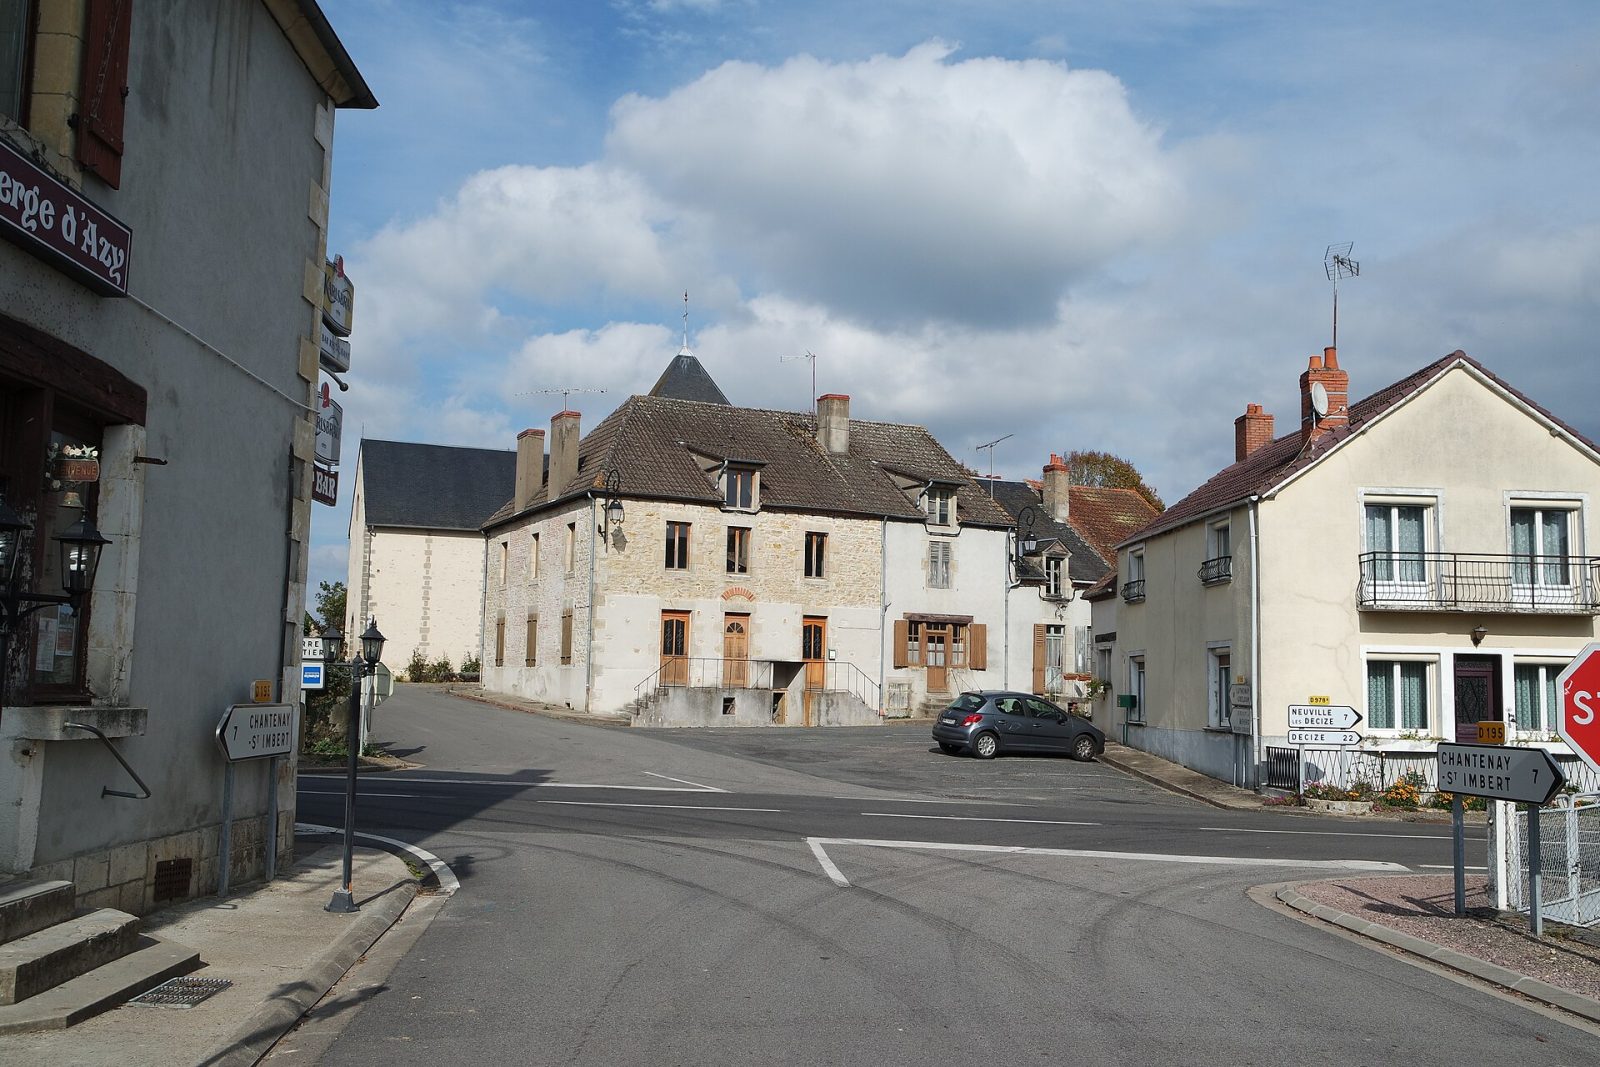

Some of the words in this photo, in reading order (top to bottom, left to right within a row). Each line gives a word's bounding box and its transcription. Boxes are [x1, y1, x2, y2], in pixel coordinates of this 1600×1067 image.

[61, 204, 125, 286] d'Azy
[315, 471, 335, 499] BAR
[1291, 708, 1332, 716] NEUVILLE
[1572, 690, 1600, 725] S
[249, 713, 291, 729] CHANTENAY
[1304, 717, 1334, 725] DECIZE
[233, 726, 238, 741] 7
[262, 731, 289, 749] IMBERT
[1291, 733, 1325, 741] DECIZE
[1342, 734, 1354, 742] 22
[1441, 751, 1511, 771] CHANTENAY
[1463, 772, 1511, 792] IMBERT
[1532, 769, 1539, 784] 7
